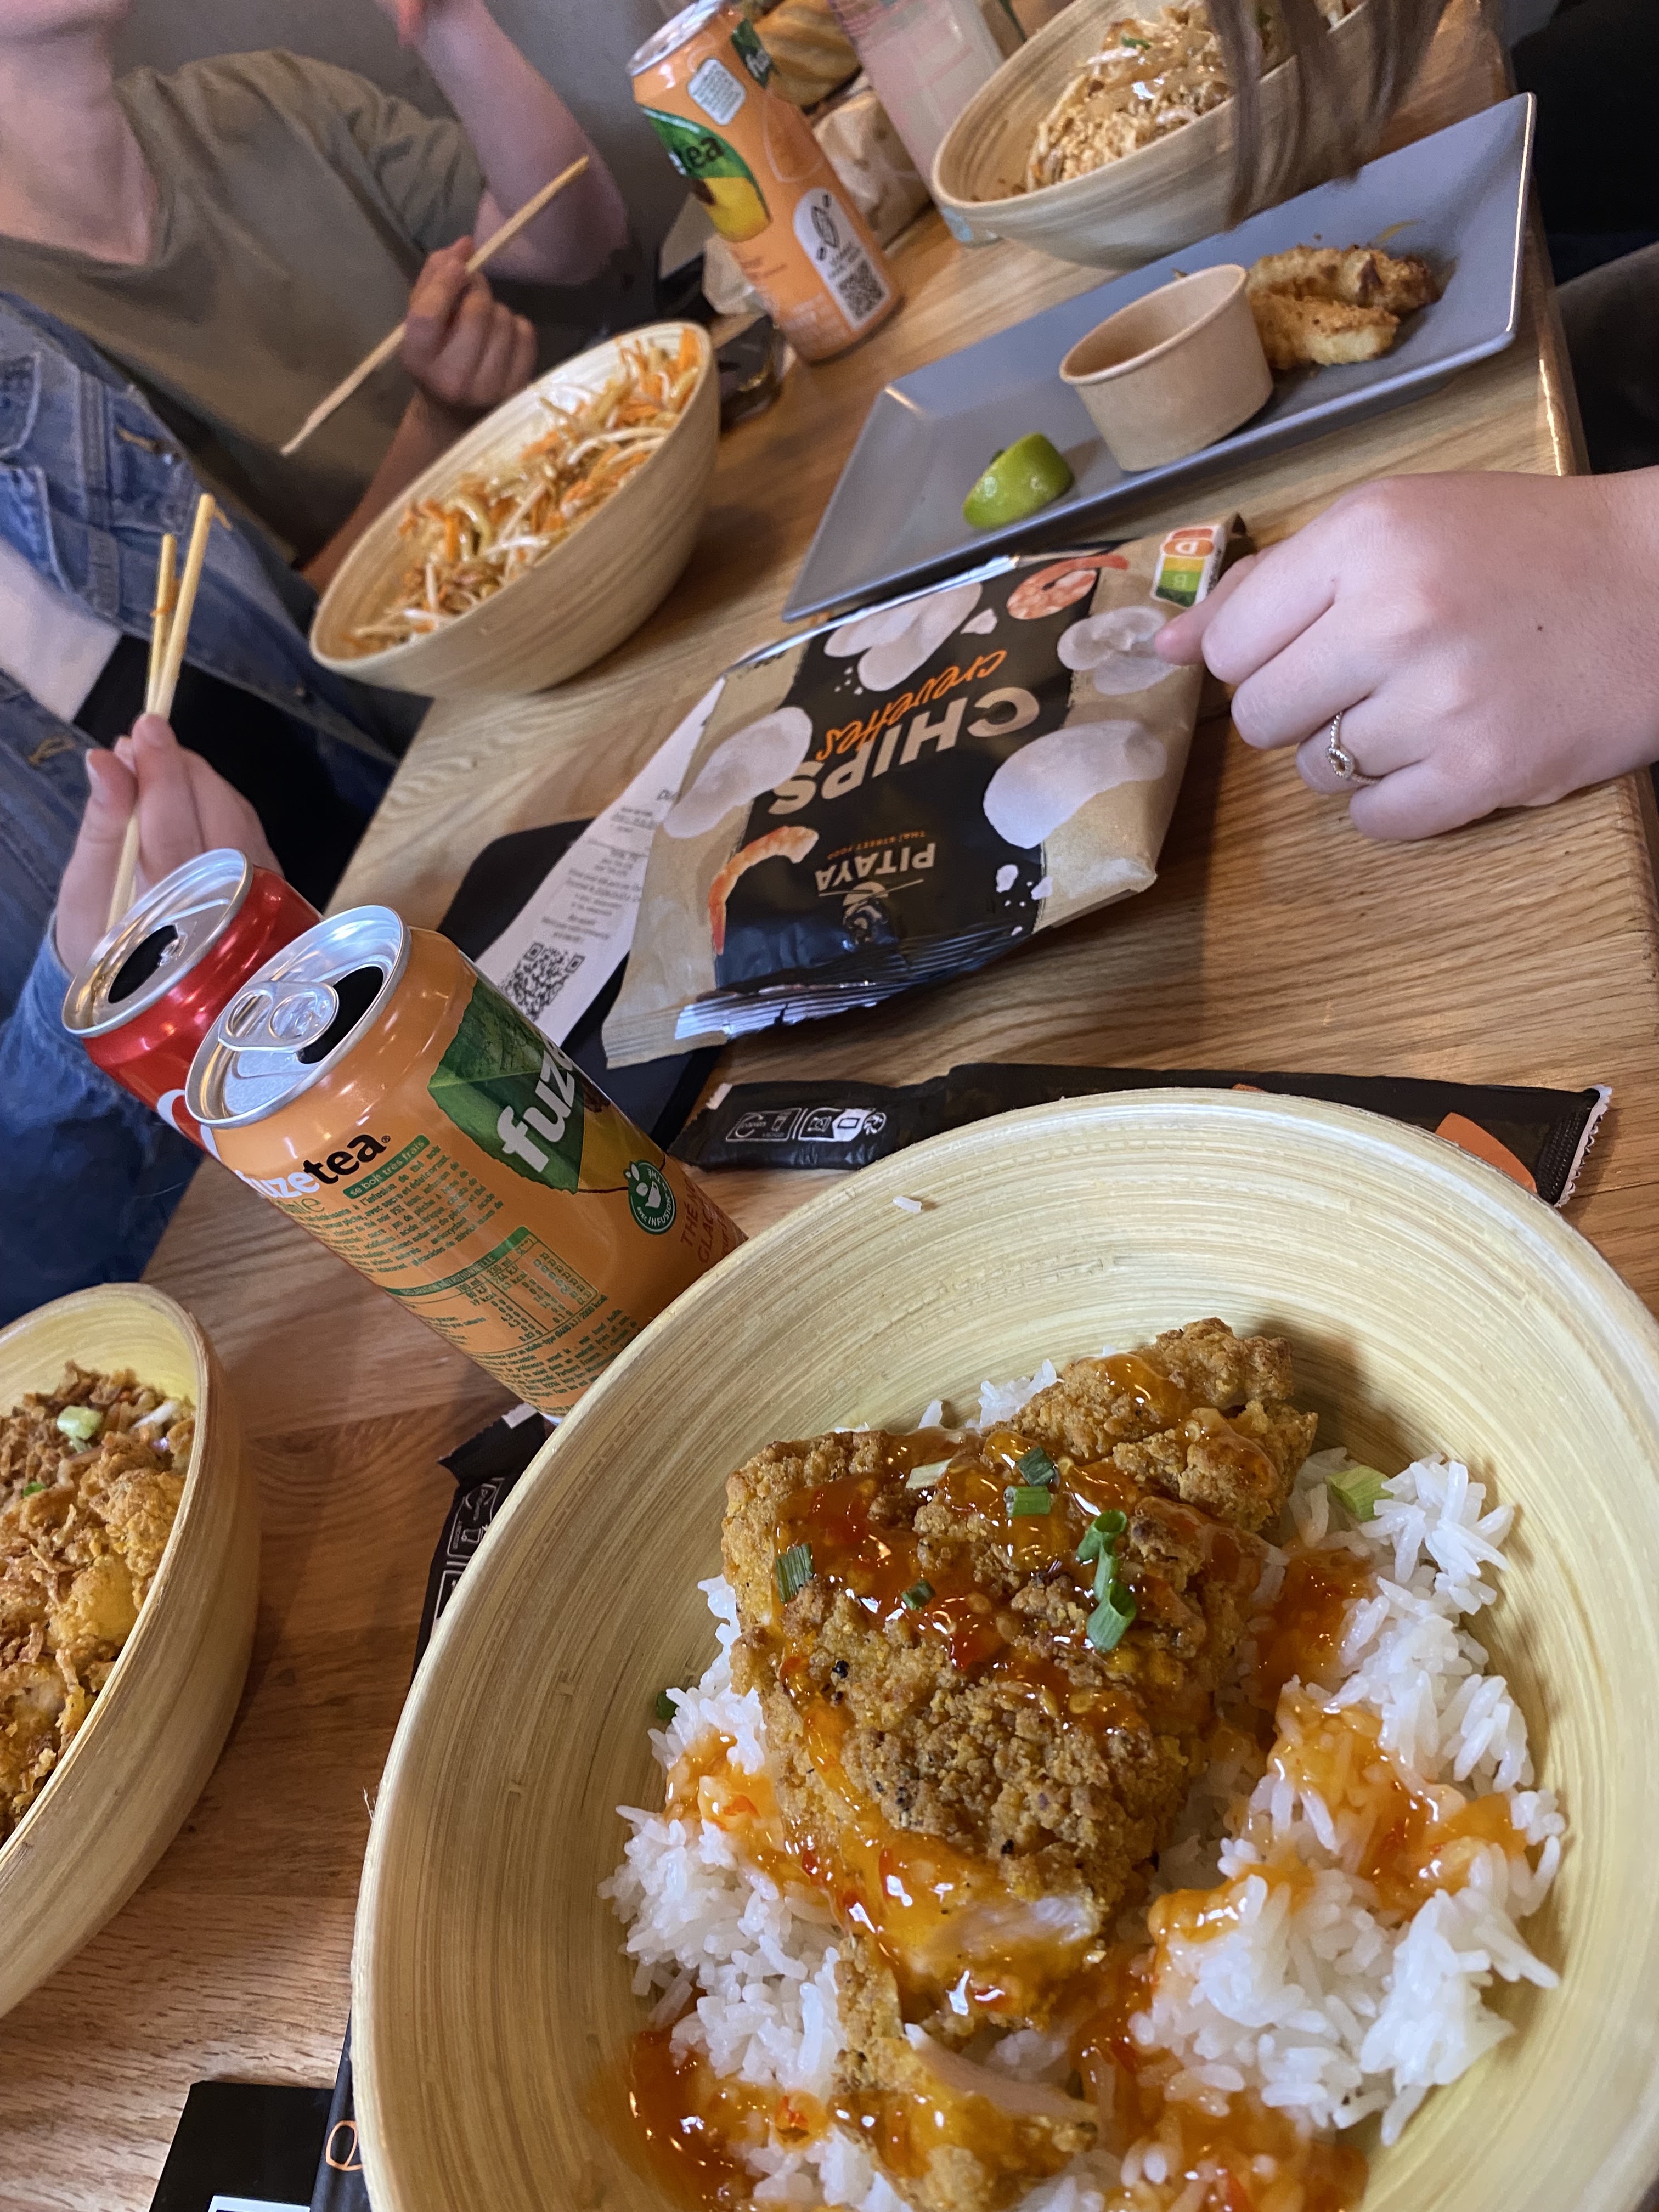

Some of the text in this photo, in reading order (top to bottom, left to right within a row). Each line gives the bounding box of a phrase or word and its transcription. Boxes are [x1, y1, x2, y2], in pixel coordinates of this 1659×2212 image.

[816, 650, 1007, 761] crevettes
[768, 687, 1039, 815] CHIPS
[815, 842, 935, 886] PITAYA
[382, 1159, 404, 1176] très
[402, 1141, 425, 1161] frais
